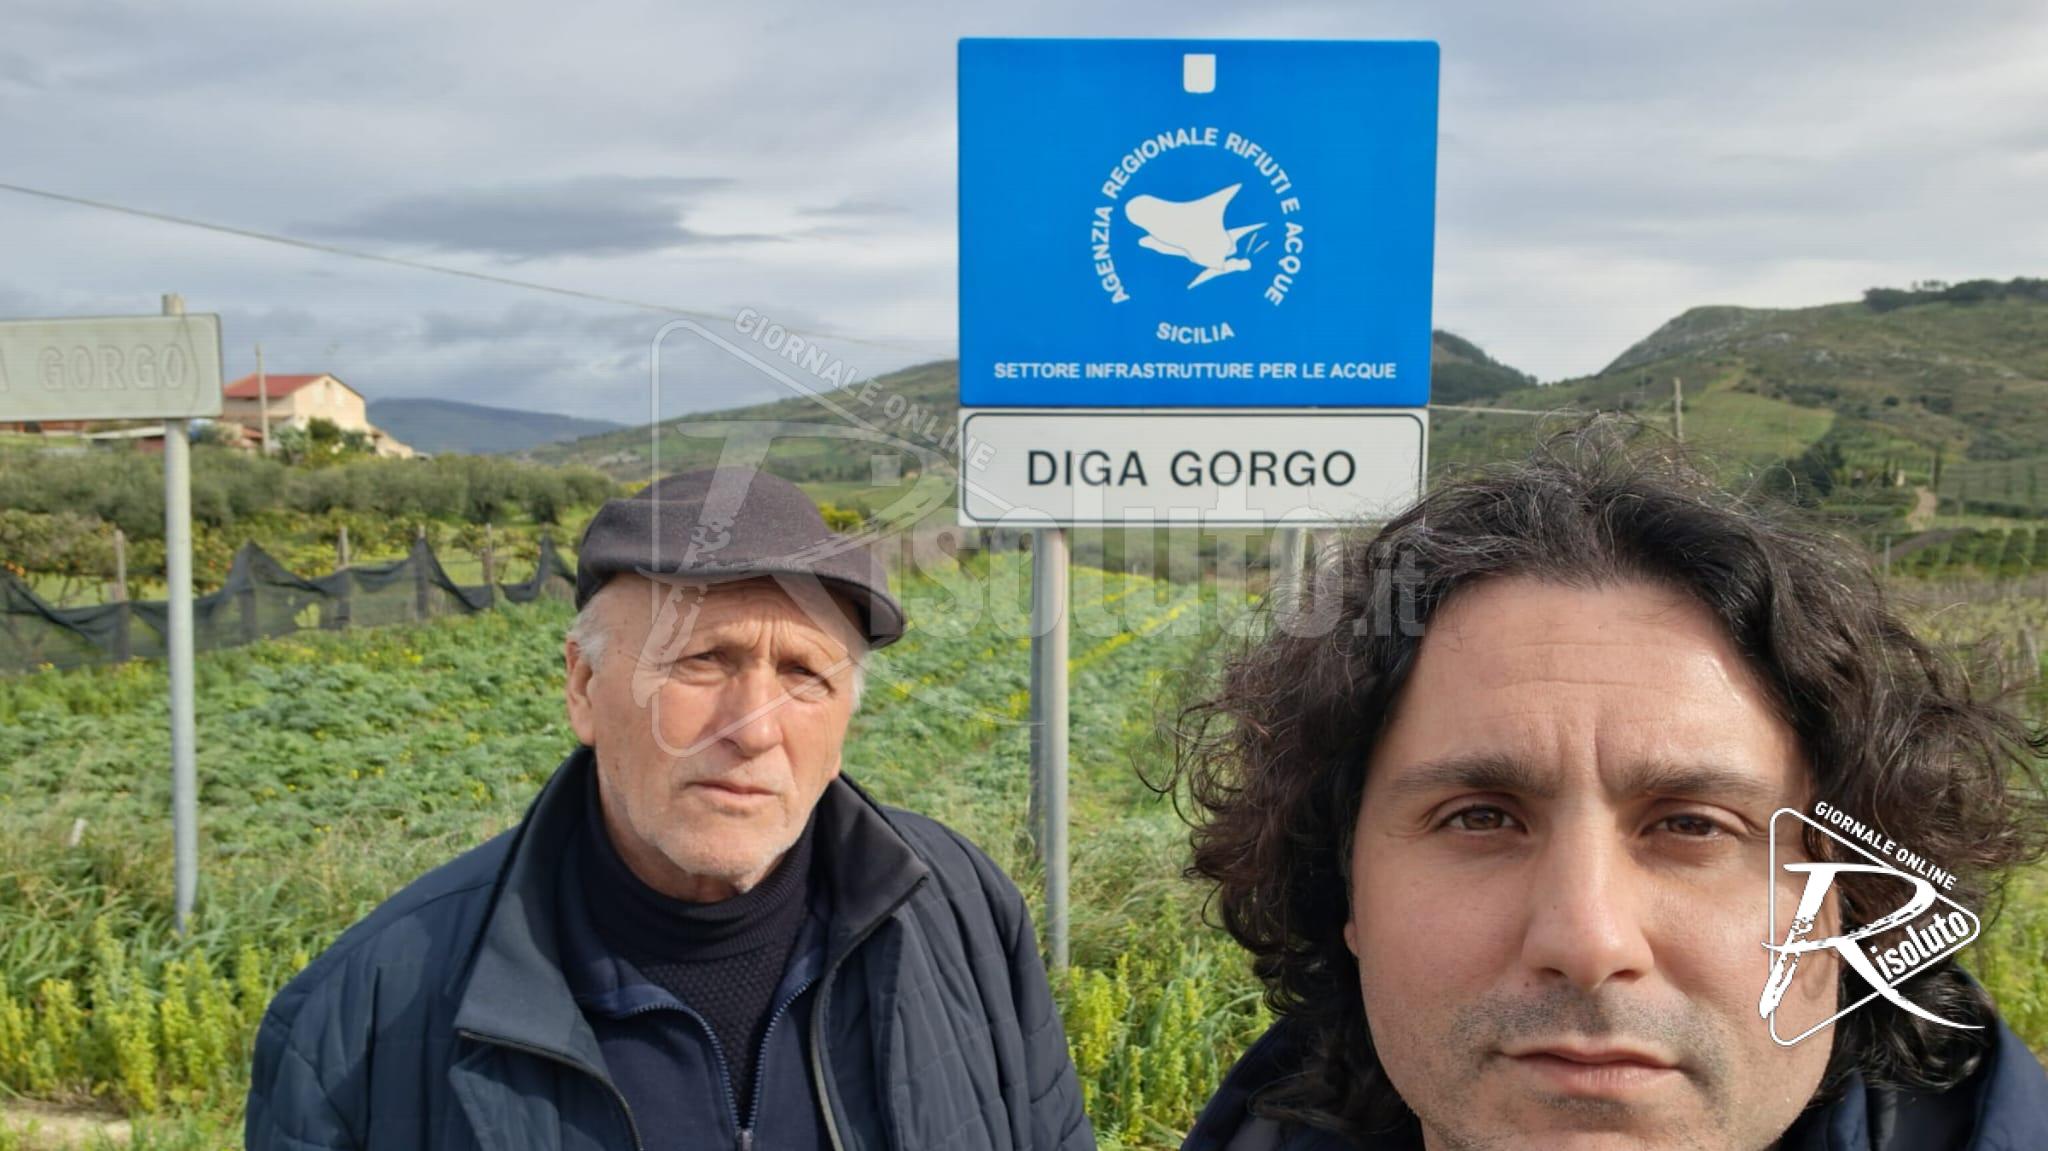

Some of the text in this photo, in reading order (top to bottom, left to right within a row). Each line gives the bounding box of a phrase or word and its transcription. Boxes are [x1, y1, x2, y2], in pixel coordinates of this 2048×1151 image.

[1091, 127, 1304, 306] AGENZIA REGIONALE RIFIUTI E ACQUE
[1156, 322, 1235, 344] SICILIA
[38, 344, 187, 392] GORGO
[994, 362, 1397, 379] SETTORE INFRASTRUTTURE PER LE ACQUE
[1028, 450, 1357, 487] DIGA GORGO
